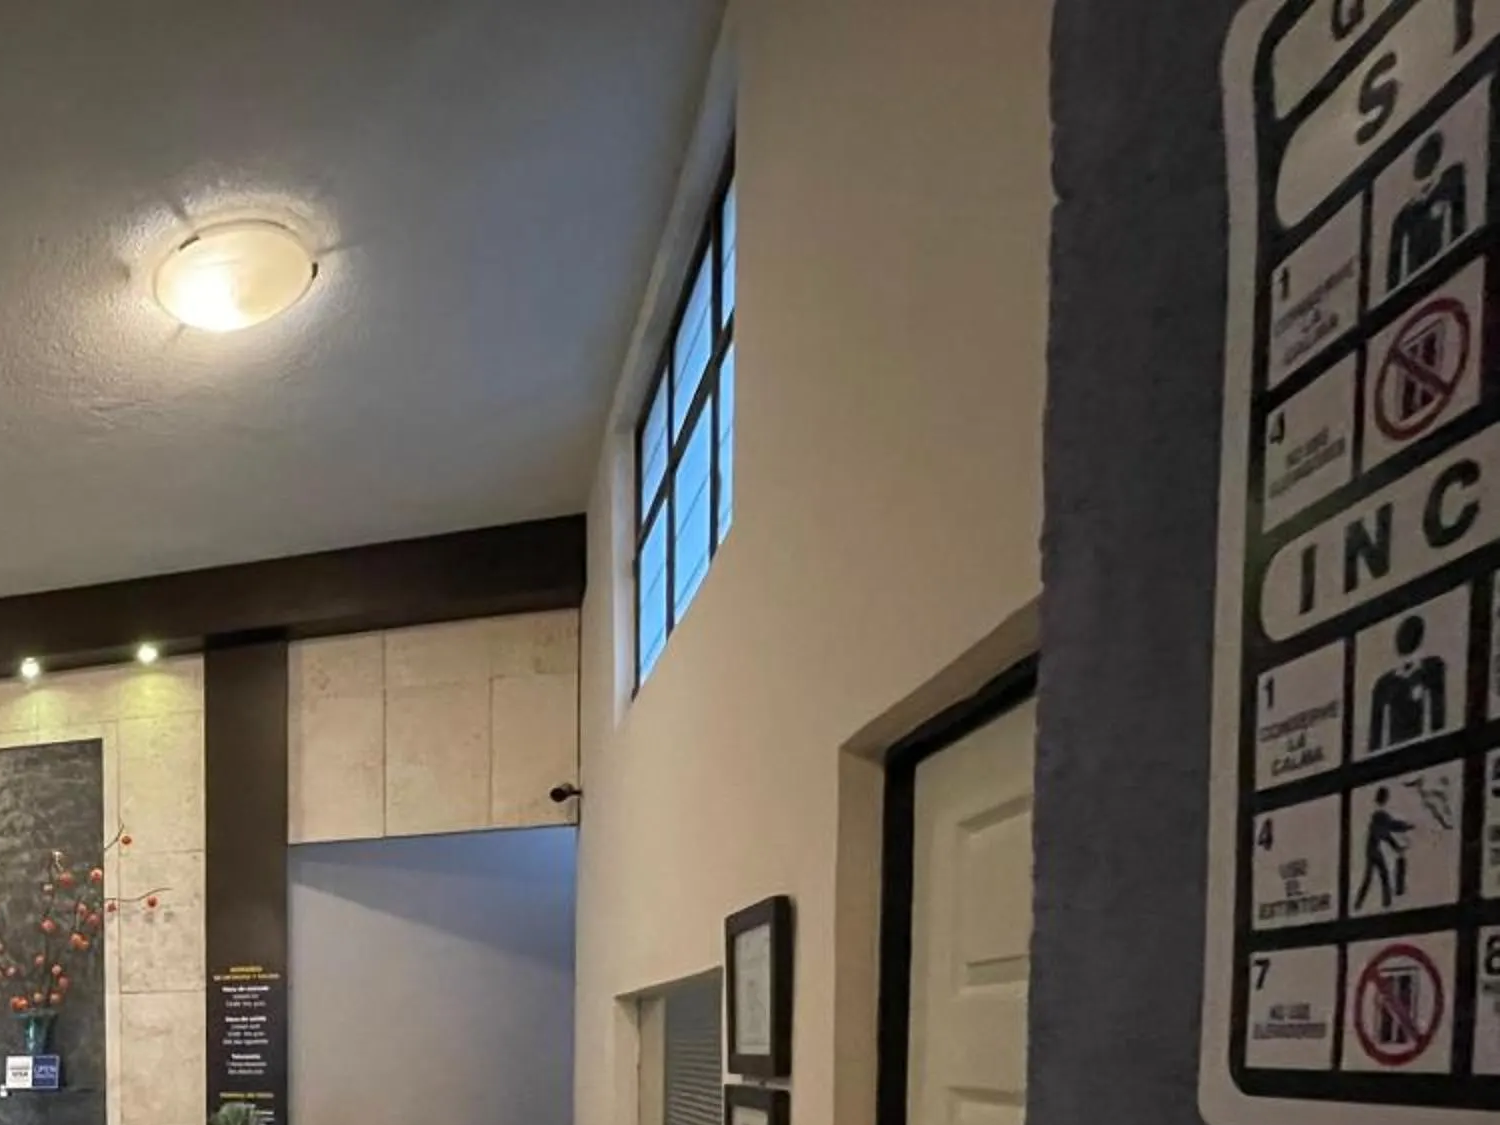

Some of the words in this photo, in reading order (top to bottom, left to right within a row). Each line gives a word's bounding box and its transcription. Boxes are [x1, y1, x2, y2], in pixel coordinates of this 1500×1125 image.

[1298, 458, 1481, 616] INC
[1263, 677, 1275, 708] 1
[1257, 818, 1273, 851] 4
[1253, 959, 1270, 989] 7
